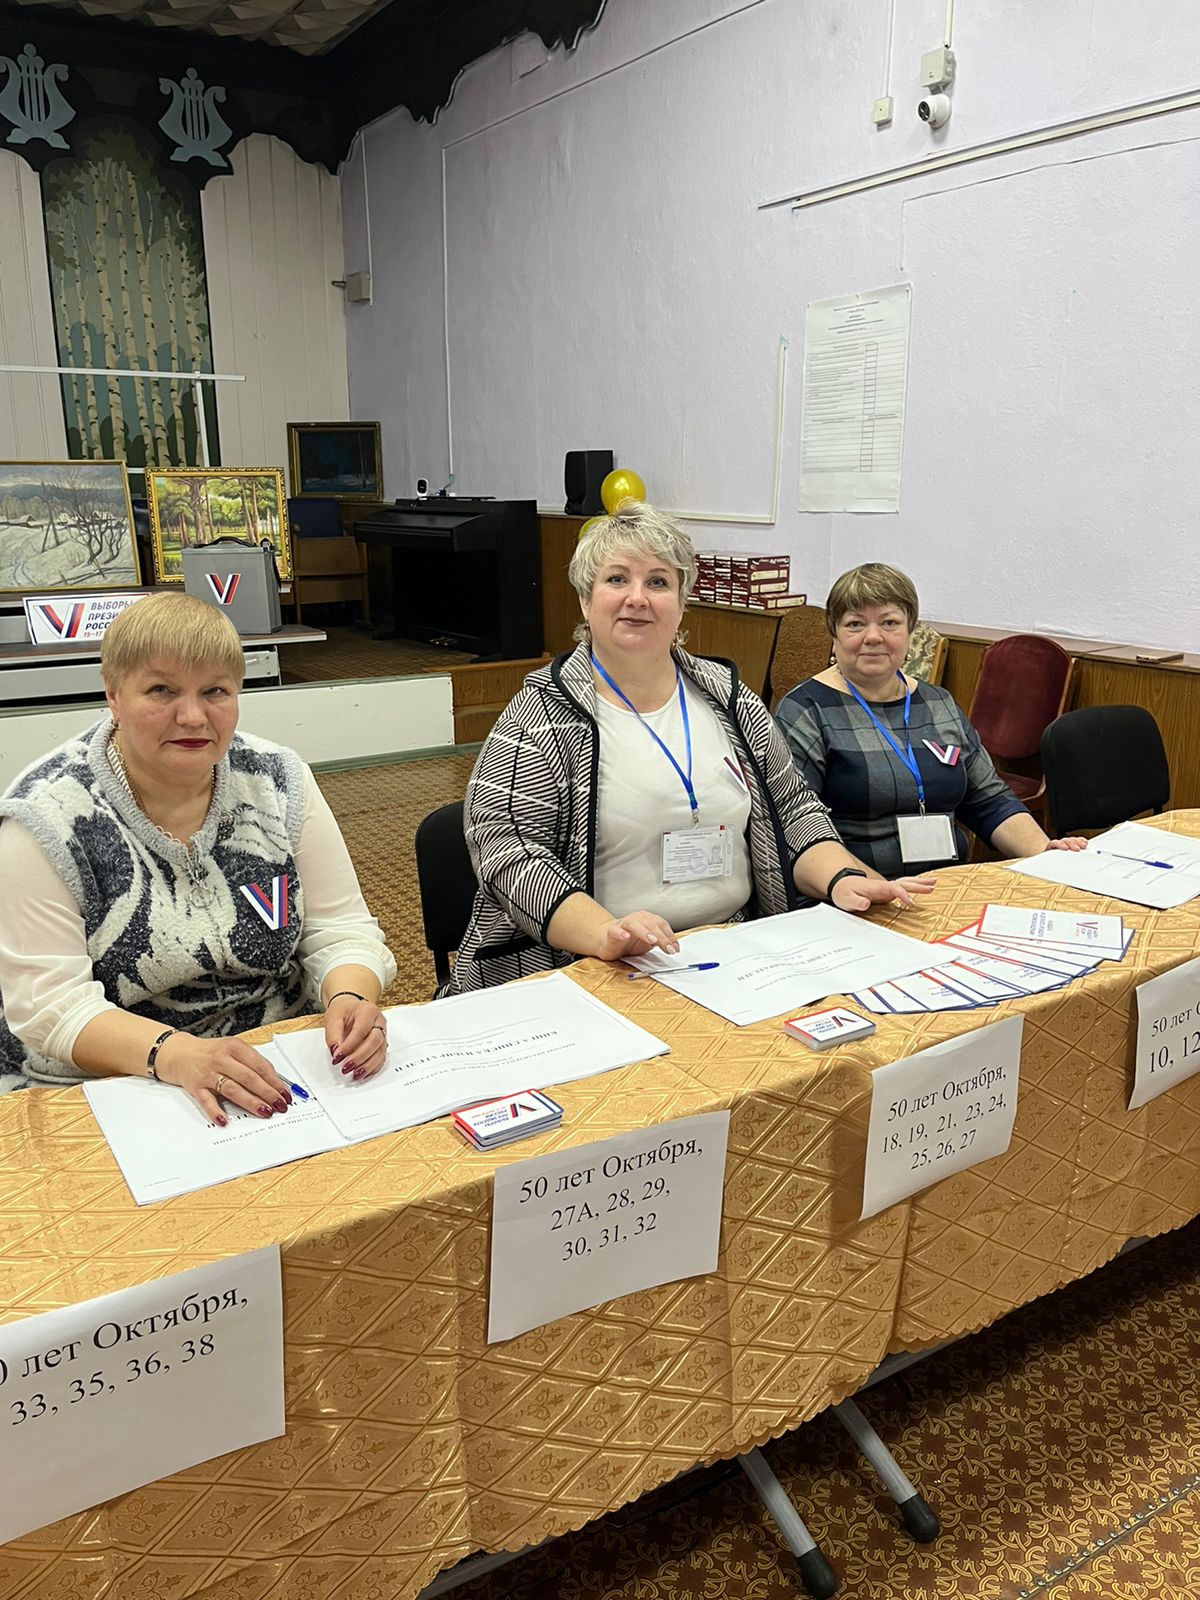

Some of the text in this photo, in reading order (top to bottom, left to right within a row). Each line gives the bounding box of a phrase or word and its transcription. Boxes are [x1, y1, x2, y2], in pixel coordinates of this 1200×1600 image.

[85, 621, 110, 631] РОСС
[88, 612, 118, 621] ПРЕЗИ
[1151, 1016, 1167, 1037] 50
[1170, 1008, 1192, 1028] лет
[1149, 1045, 1174, 1073] 10,
[887, 1063, 1007, 1122] 50 лет Октября,
[882, 1092, 1007, 1153] 18, 19, 21, 23, 24,
[519, 1138, 703, 1204] 50 лет Октября,
[910, 1129, 976, 1170] 25, 26, 27
[550, 1177, 671, 1232] 27А, 28, 29,
[561, 1212, 657, 1261] 30, 31, 32
[21, 1341, 82, 1378] лет
[93, 1287, 248, 1350] Октября,
[10, 1333, 215, 1426] 33, 35, 36, 38
